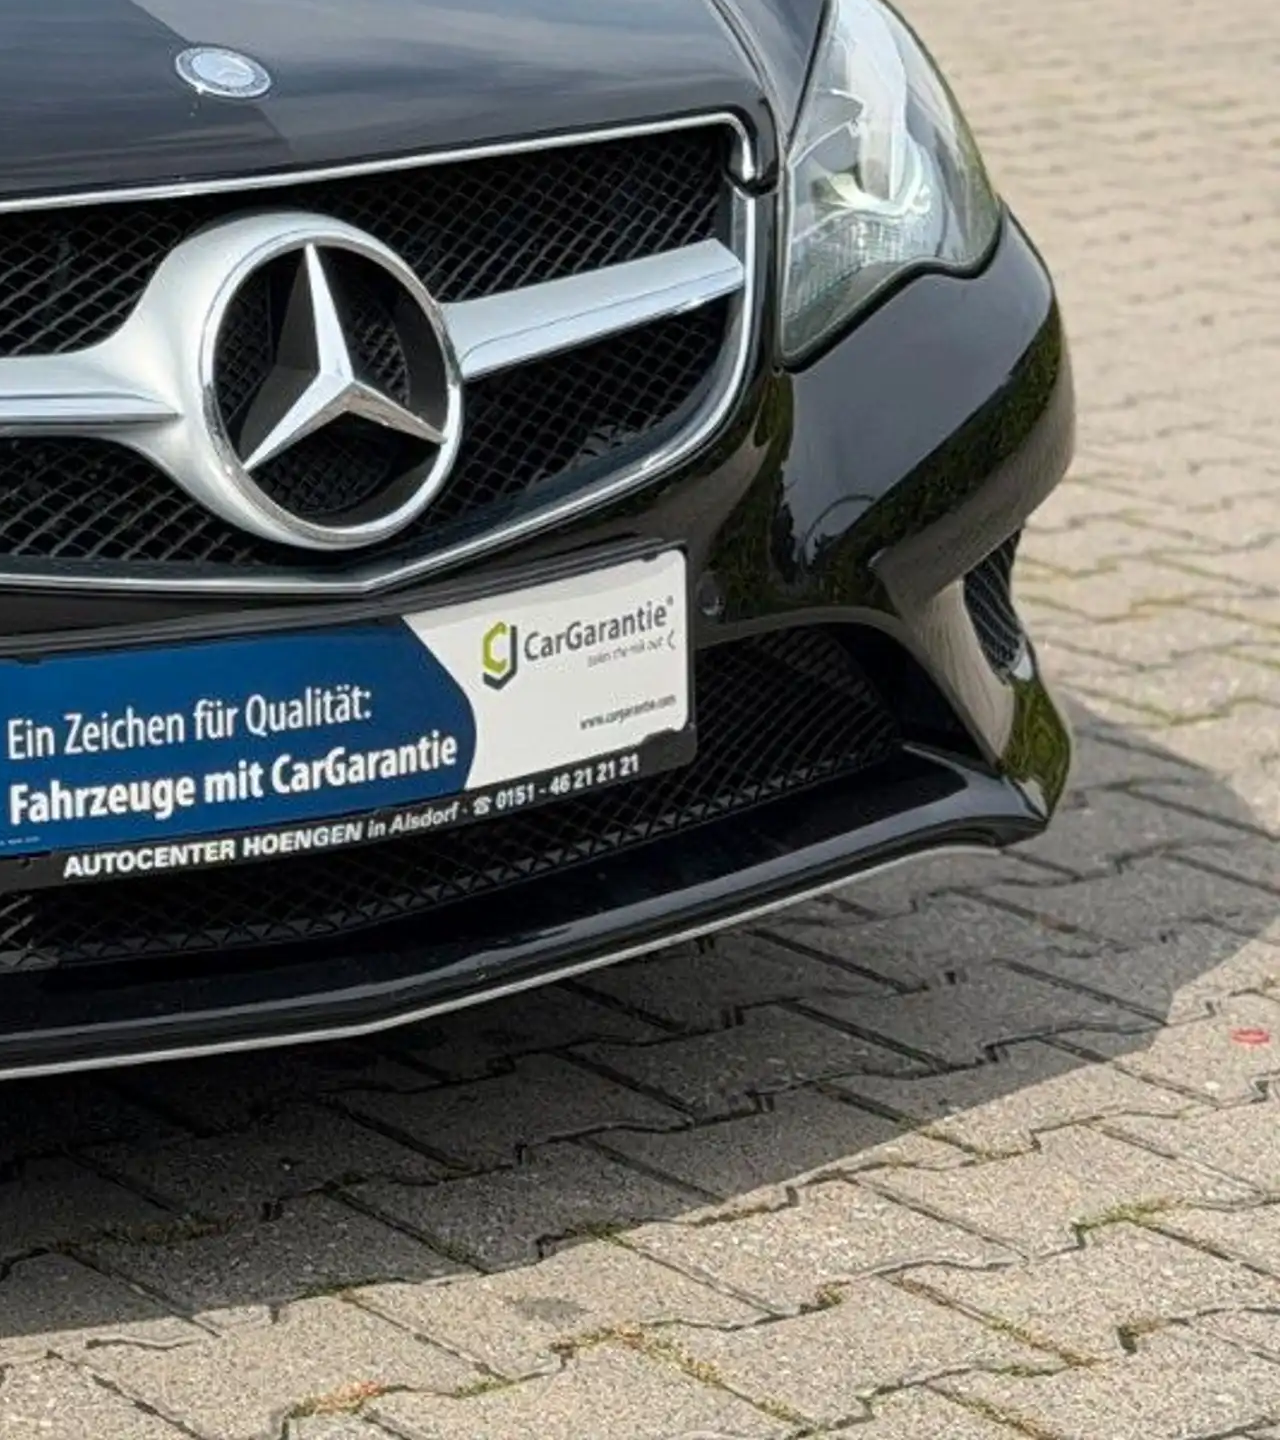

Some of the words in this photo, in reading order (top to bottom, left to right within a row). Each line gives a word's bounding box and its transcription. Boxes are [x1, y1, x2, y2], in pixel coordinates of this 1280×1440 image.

[7, 718, 55, 760] Ein
[63, 705, 185, 755] Zeichen
[193, 698, 239, 741] für
[245, 684, 372, 737] Qualität:
[9, 776, 196, 826] Fahrzeuge
[204, 759, 264, 803] mit
[271, 729, 458, 794] CarGarantie
[63, 838, 236, 879] AUTOCENTER
[242, 820, 363, 857] HOENGEN
[367, 819, 386, 839] in
[389, 801, 460, 834] Alsdorf
[495, 782, 535, 811] 0151
[549, 772, 571, 796] 46
[573, 767, 592, 790] 21
[596, 759, 615, 784] 21
[619, 753, 639, 778] 21
